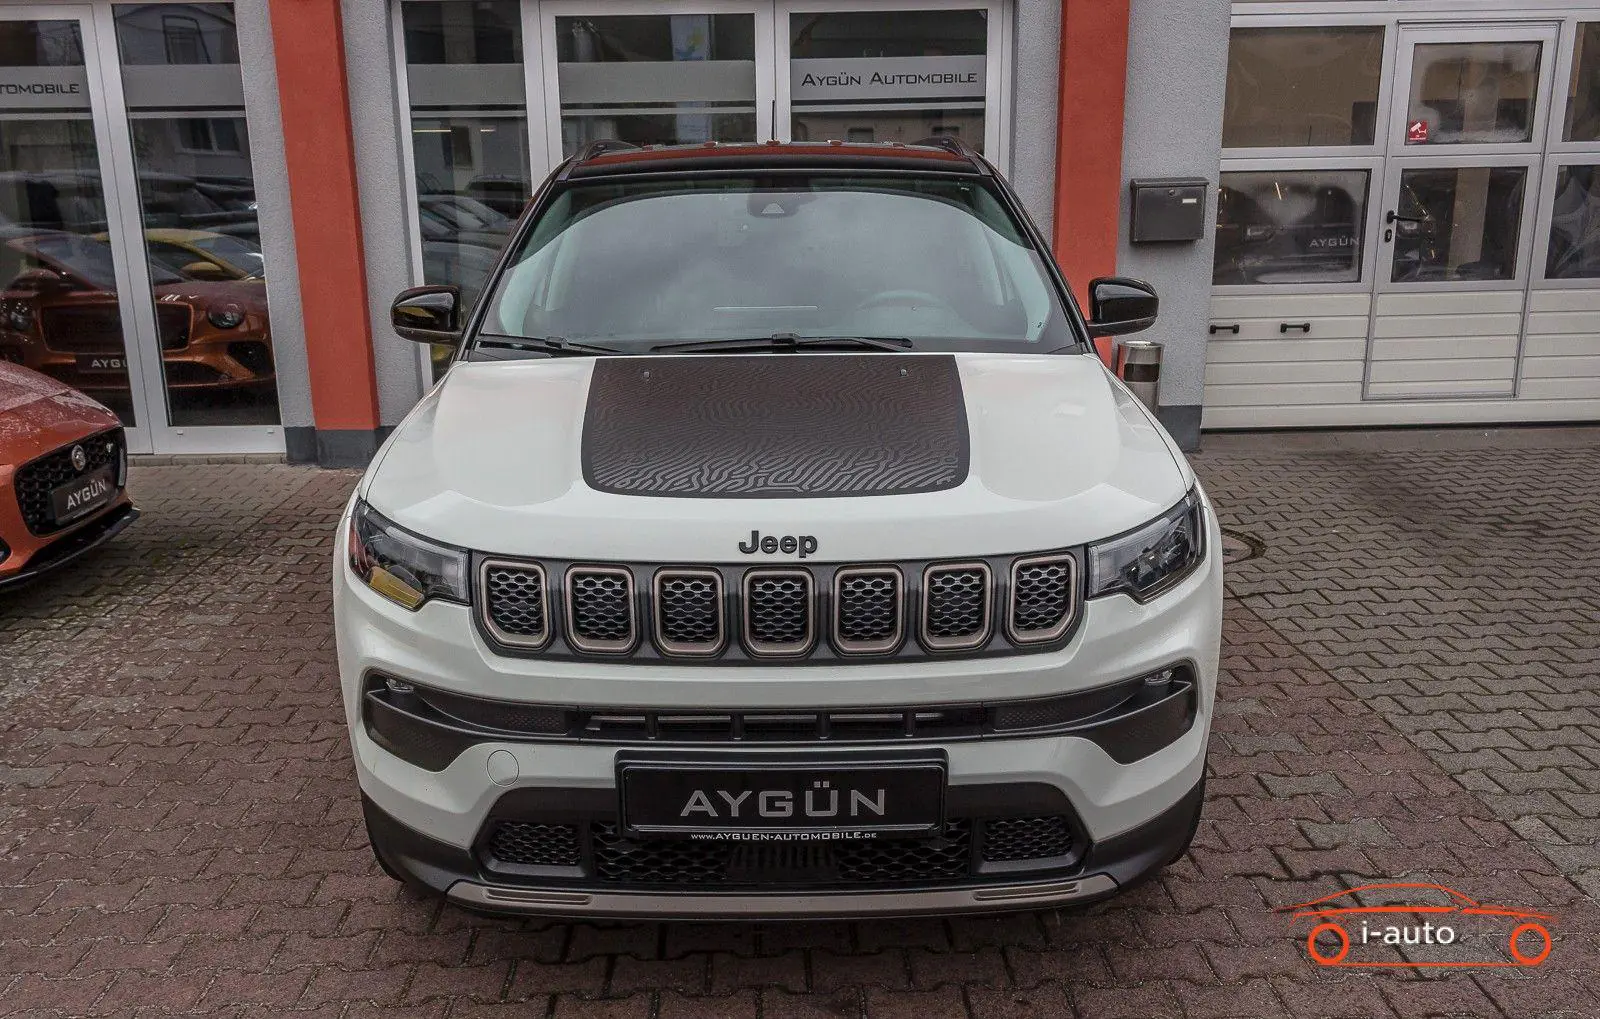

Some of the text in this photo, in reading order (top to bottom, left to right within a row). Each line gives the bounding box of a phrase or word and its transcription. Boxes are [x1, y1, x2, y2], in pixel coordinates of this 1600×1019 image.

[1309, 235, 1360, 248] AYGÜN
[67, 479, 107, 510] AYGÜN
[738, 530, 818, 558] Jeep
[680, 781, 885, 817] AYGÜN
